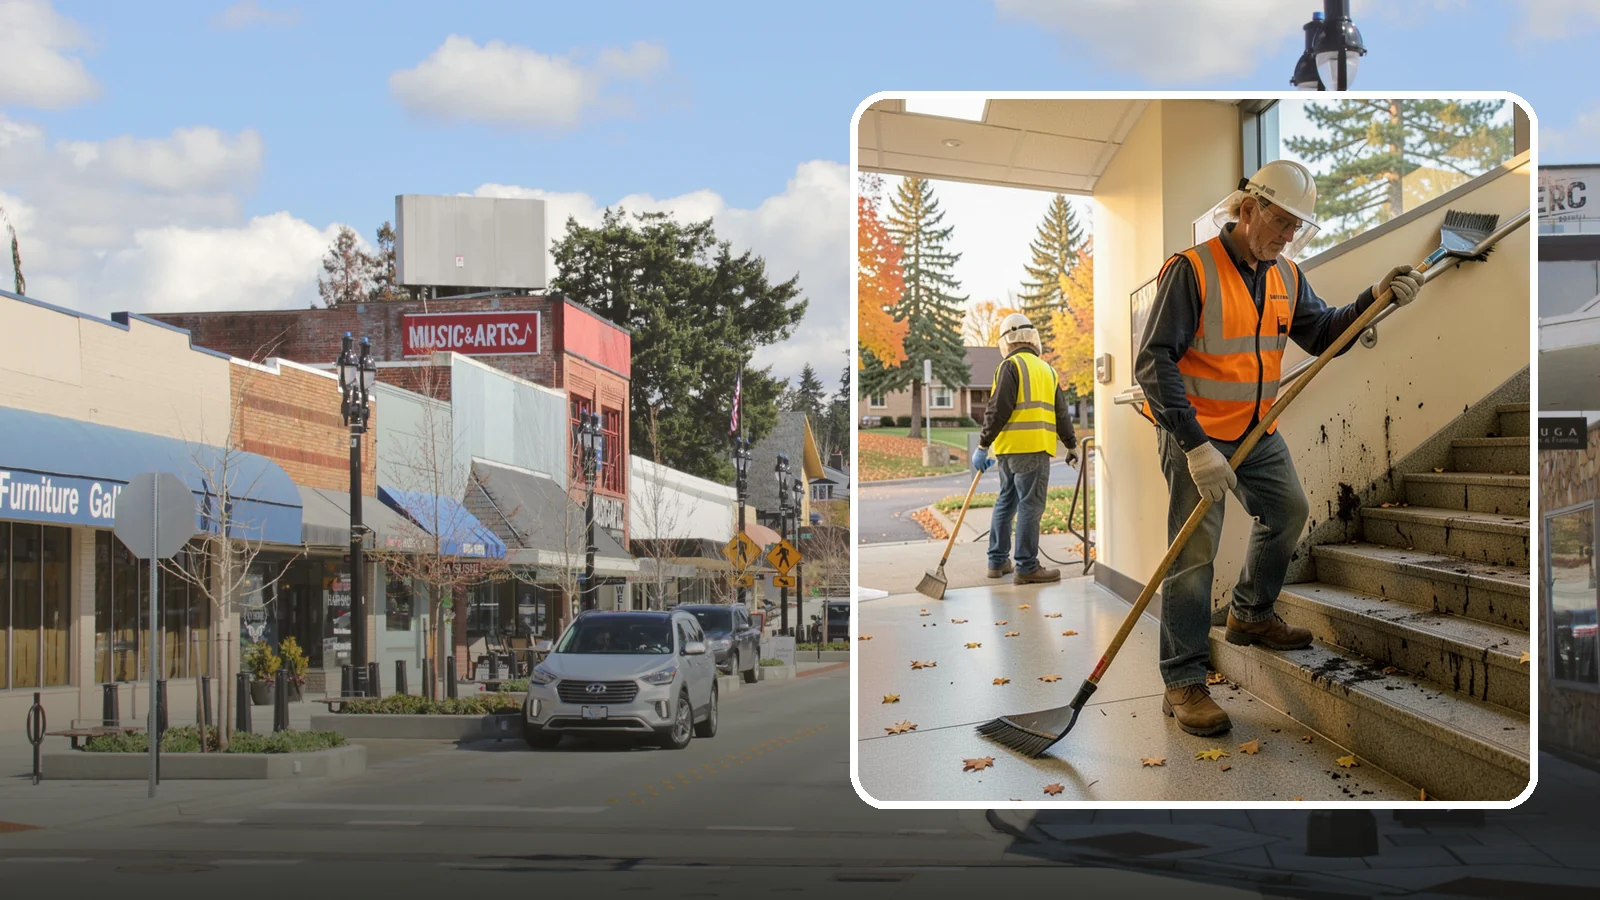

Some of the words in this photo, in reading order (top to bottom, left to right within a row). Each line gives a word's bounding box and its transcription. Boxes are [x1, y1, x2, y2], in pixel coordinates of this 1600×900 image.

[1540, 427, 1577, 437] UGA
[0, 472, 79, 515] Furniture
[89, 482, 122, 519] Gal
[453, 563, 479, 574] SUSHI
